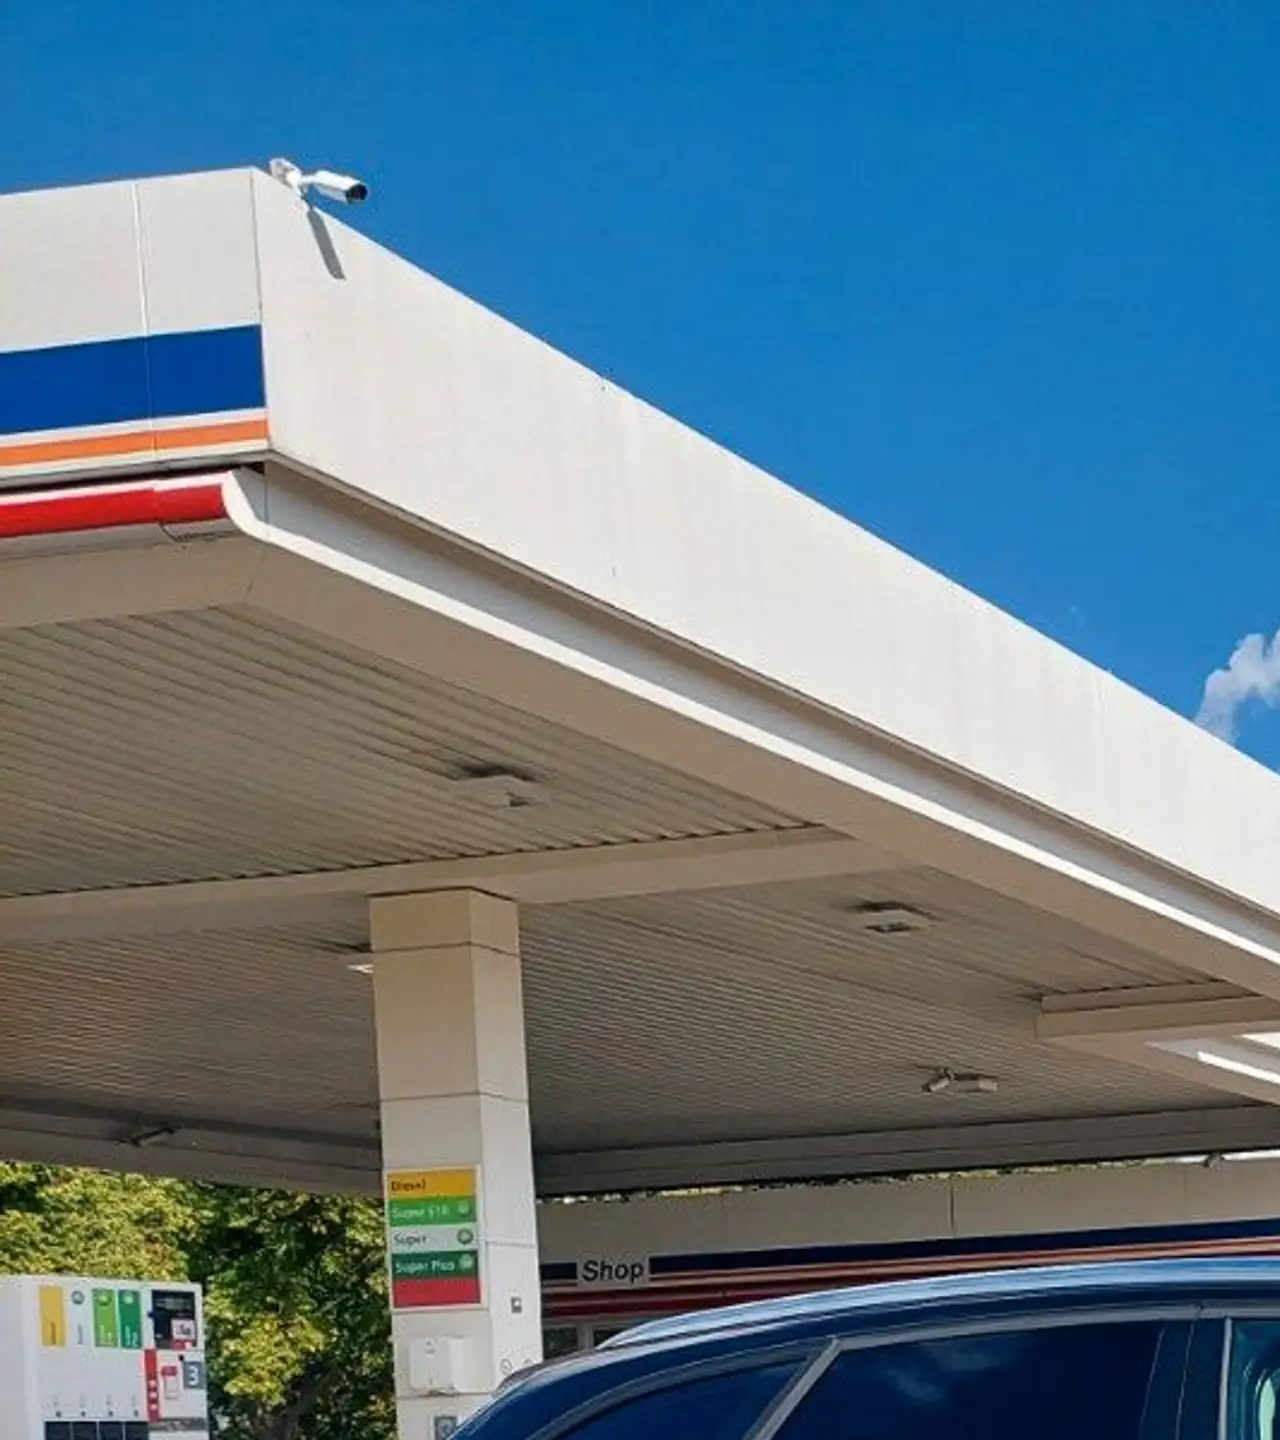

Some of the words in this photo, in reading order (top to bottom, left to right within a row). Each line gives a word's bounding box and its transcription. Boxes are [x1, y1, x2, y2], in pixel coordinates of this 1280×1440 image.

[391, 1179, 426, 1192] Diesel
[394, 1234, 427, 1247] Super
[396, 1261, 428, 1274] Super
[431, 1259, 455, 1273] Plus
[582, 1259, 644, 1285] Shop
[188, 1365, 198, 1387] 3
